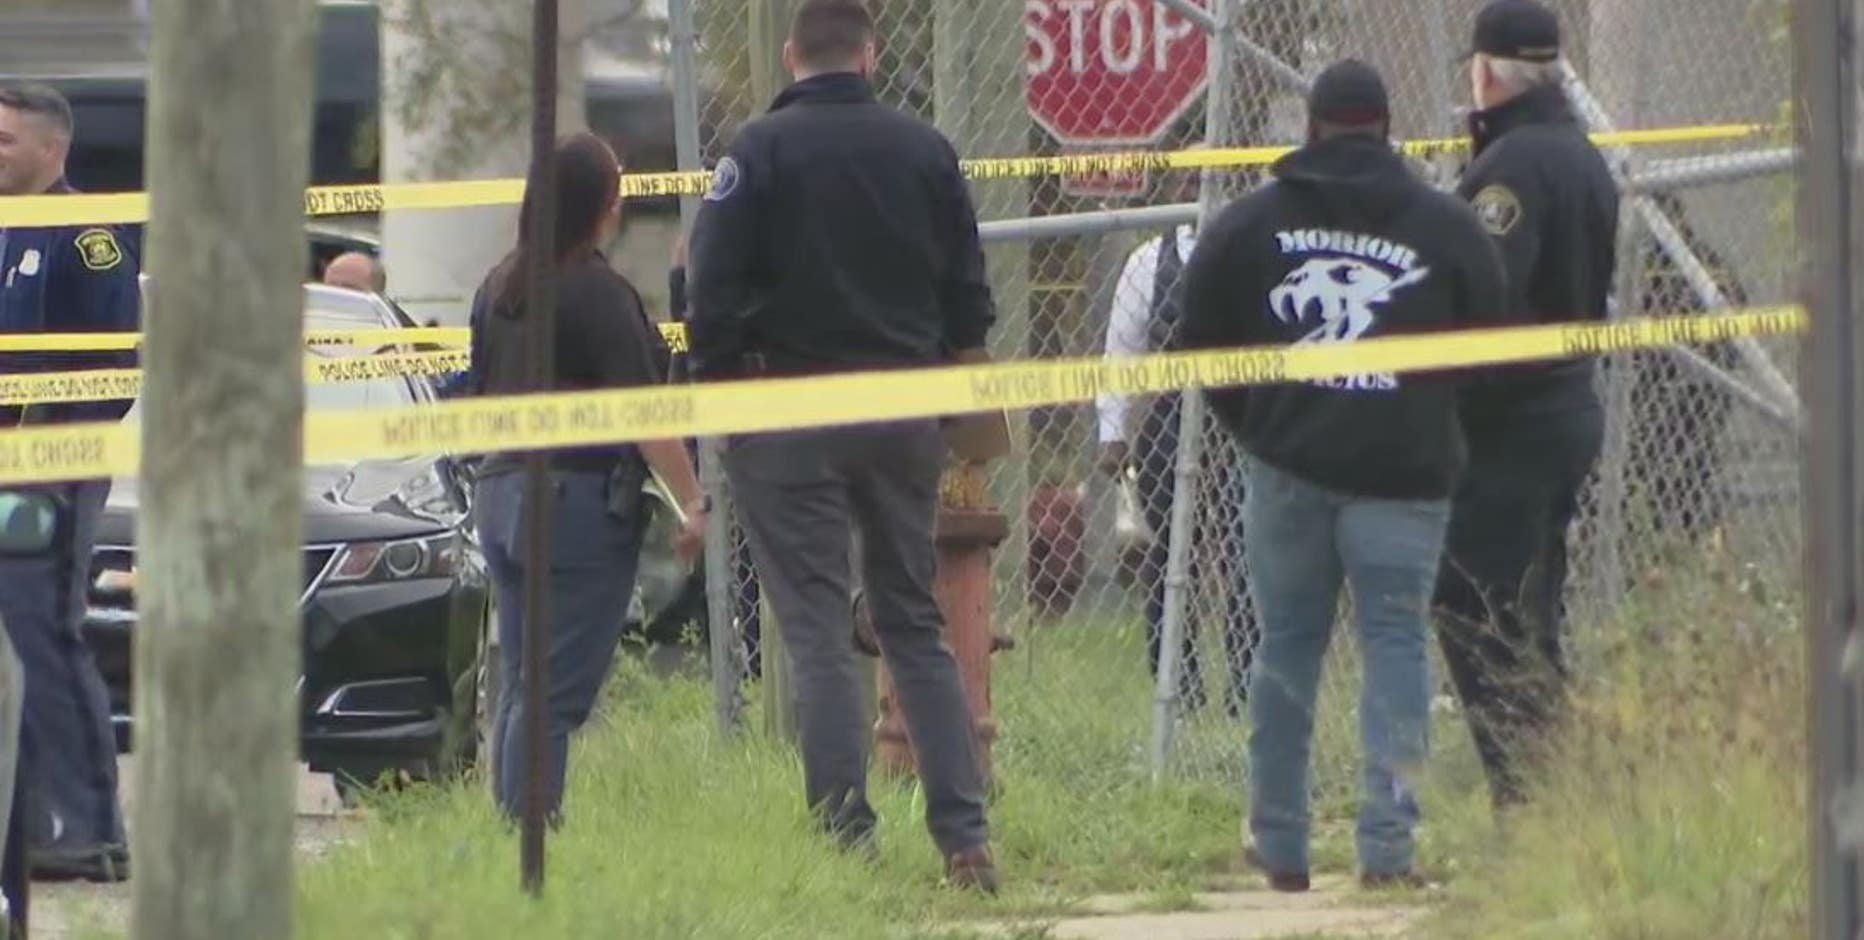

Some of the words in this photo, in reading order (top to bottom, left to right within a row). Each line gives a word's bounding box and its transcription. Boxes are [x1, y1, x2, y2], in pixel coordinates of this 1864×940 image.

[1025, 0, 1193, 74] STOP
[303, 191, 326, 213] OT
[333, 188, 384, 211] CROSS
[1275, 229, 1417, 271] MORIOR
[319, 359, 372, 382] POLICE
